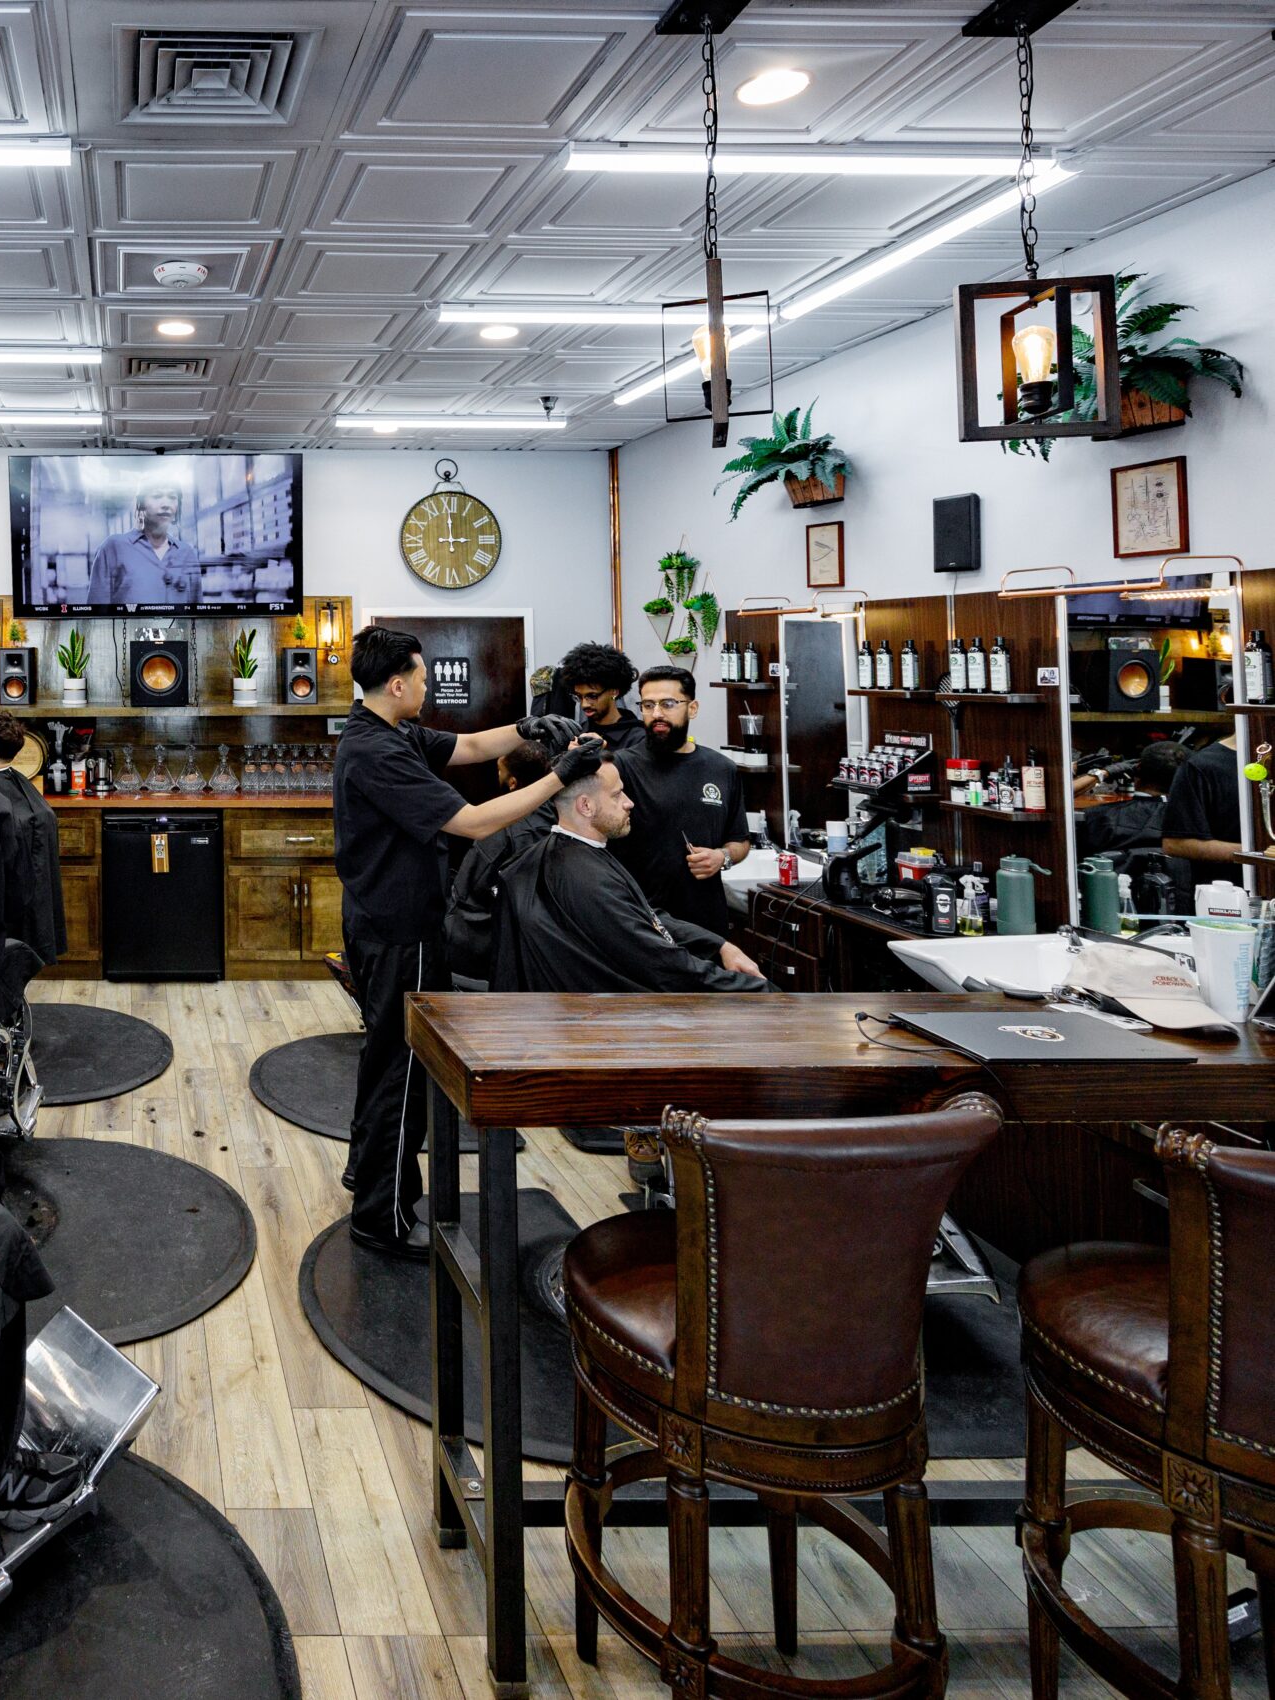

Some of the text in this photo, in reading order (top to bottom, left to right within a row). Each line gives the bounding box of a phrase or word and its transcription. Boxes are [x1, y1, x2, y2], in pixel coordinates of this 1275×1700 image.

[885, 734, 900, 744] STYLING
[910, 737, 926, 746] POWDER
[908, 775, 929, 783] UPPERCUT
[1236, 943, 1251, 979] tropical
